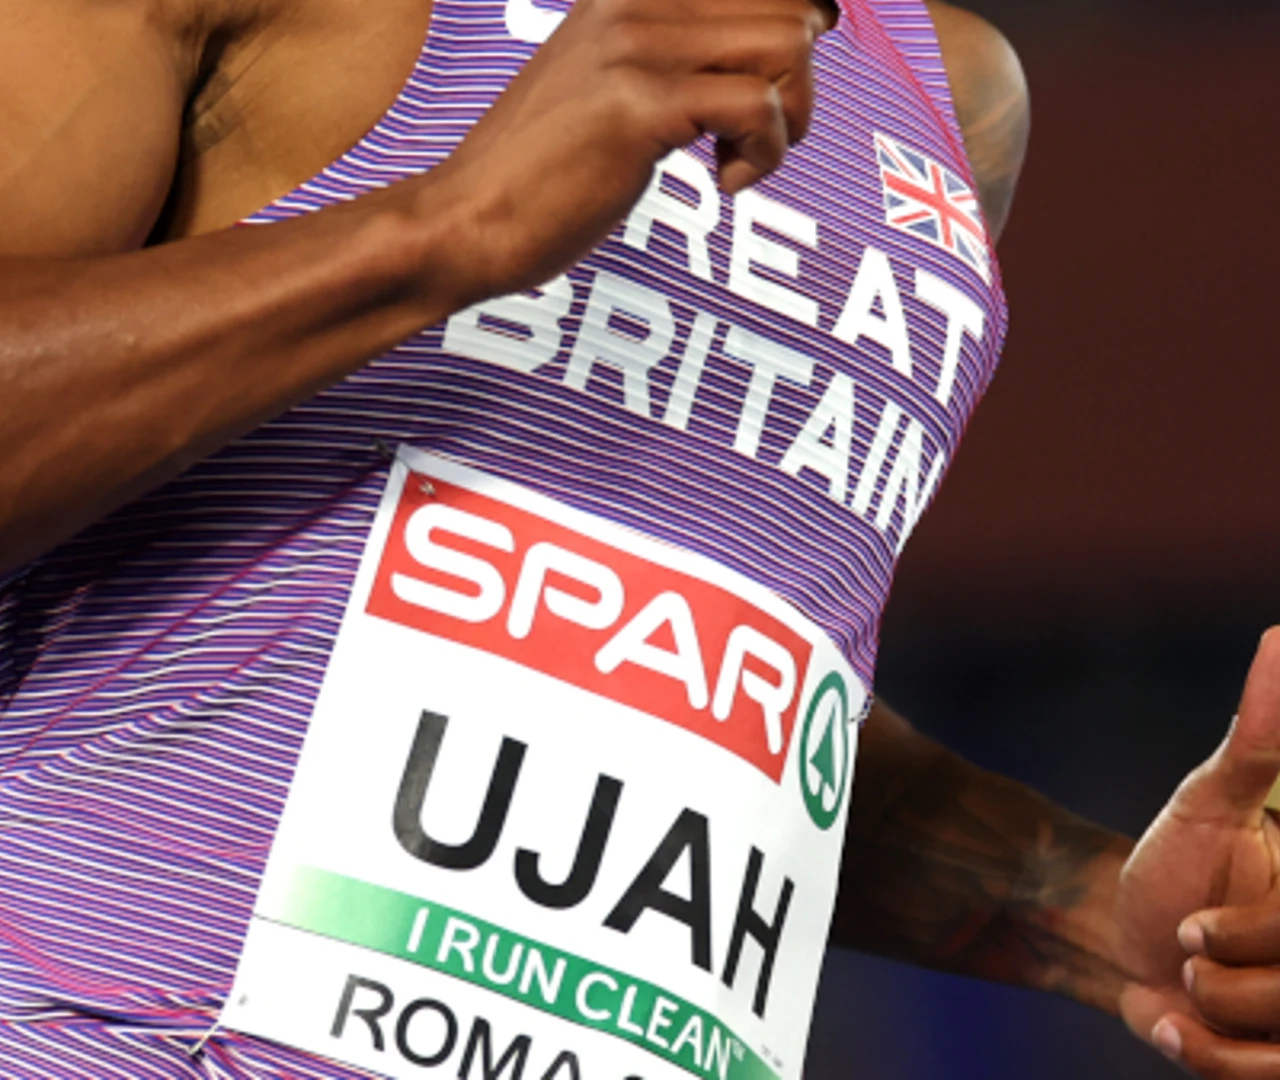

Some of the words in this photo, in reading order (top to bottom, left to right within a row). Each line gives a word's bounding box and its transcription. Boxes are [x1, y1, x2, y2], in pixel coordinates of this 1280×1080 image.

[623, 147, 984, 408] REAT
[440, 270, 945, 558] BRITAIN
[391, 503, 797, 755] SPAR
[391, 709, 795, 1019] UJAH
[406, 907, 429, 954] I
[436, 916, 567, 1005] RUN
